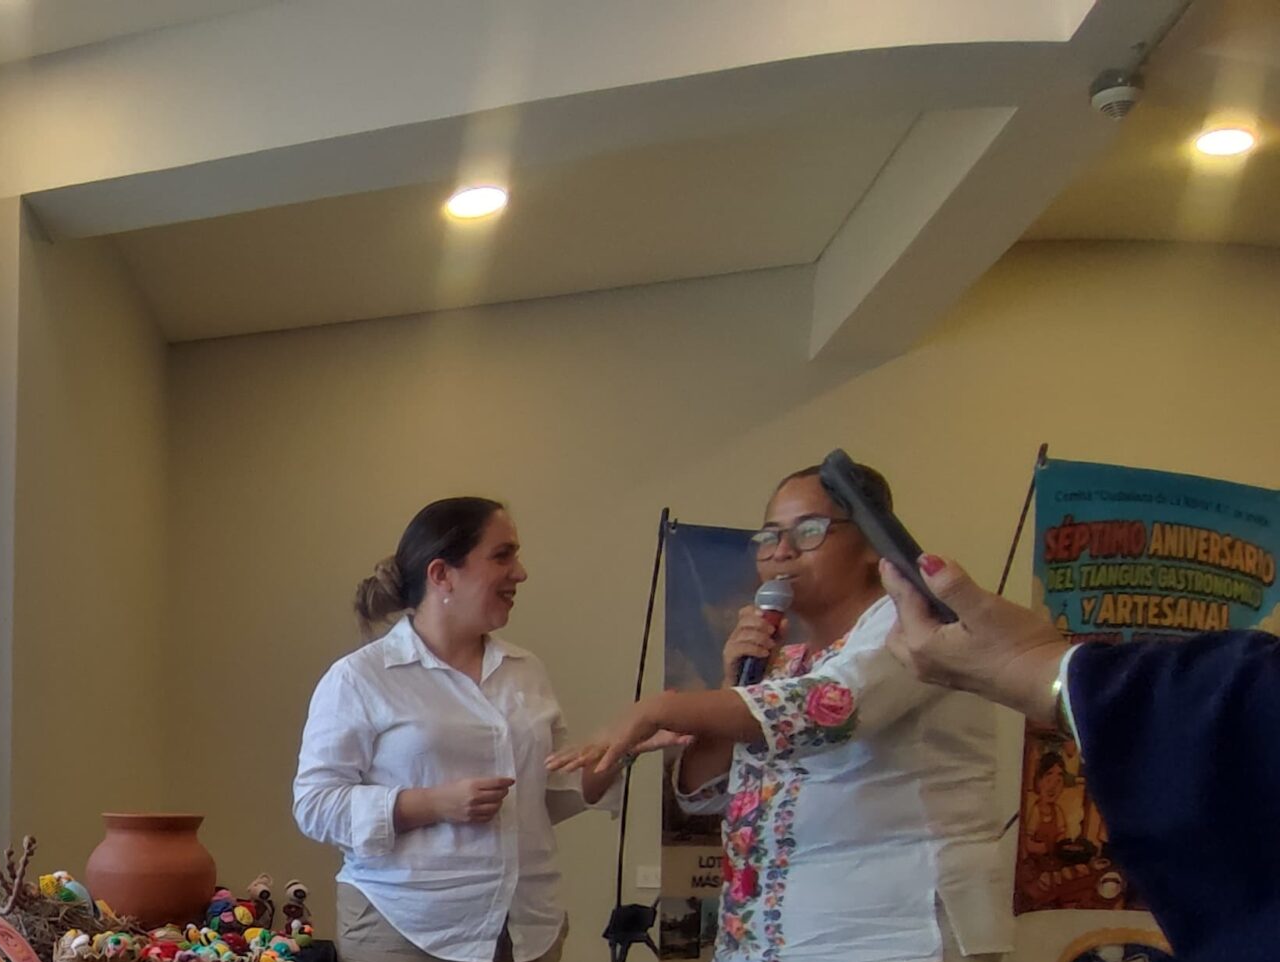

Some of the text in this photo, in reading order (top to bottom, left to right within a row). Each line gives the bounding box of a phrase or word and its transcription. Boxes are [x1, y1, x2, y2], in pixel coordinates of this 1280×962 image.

[1044, 514, 1276, 587] SÉPTIMO ANIVERSARIO
[1046, 564, 1075, 593] DEL
[1079, 563, 1154, 591] TIANGUIS
[1080, 594, 1098, 625] Y
